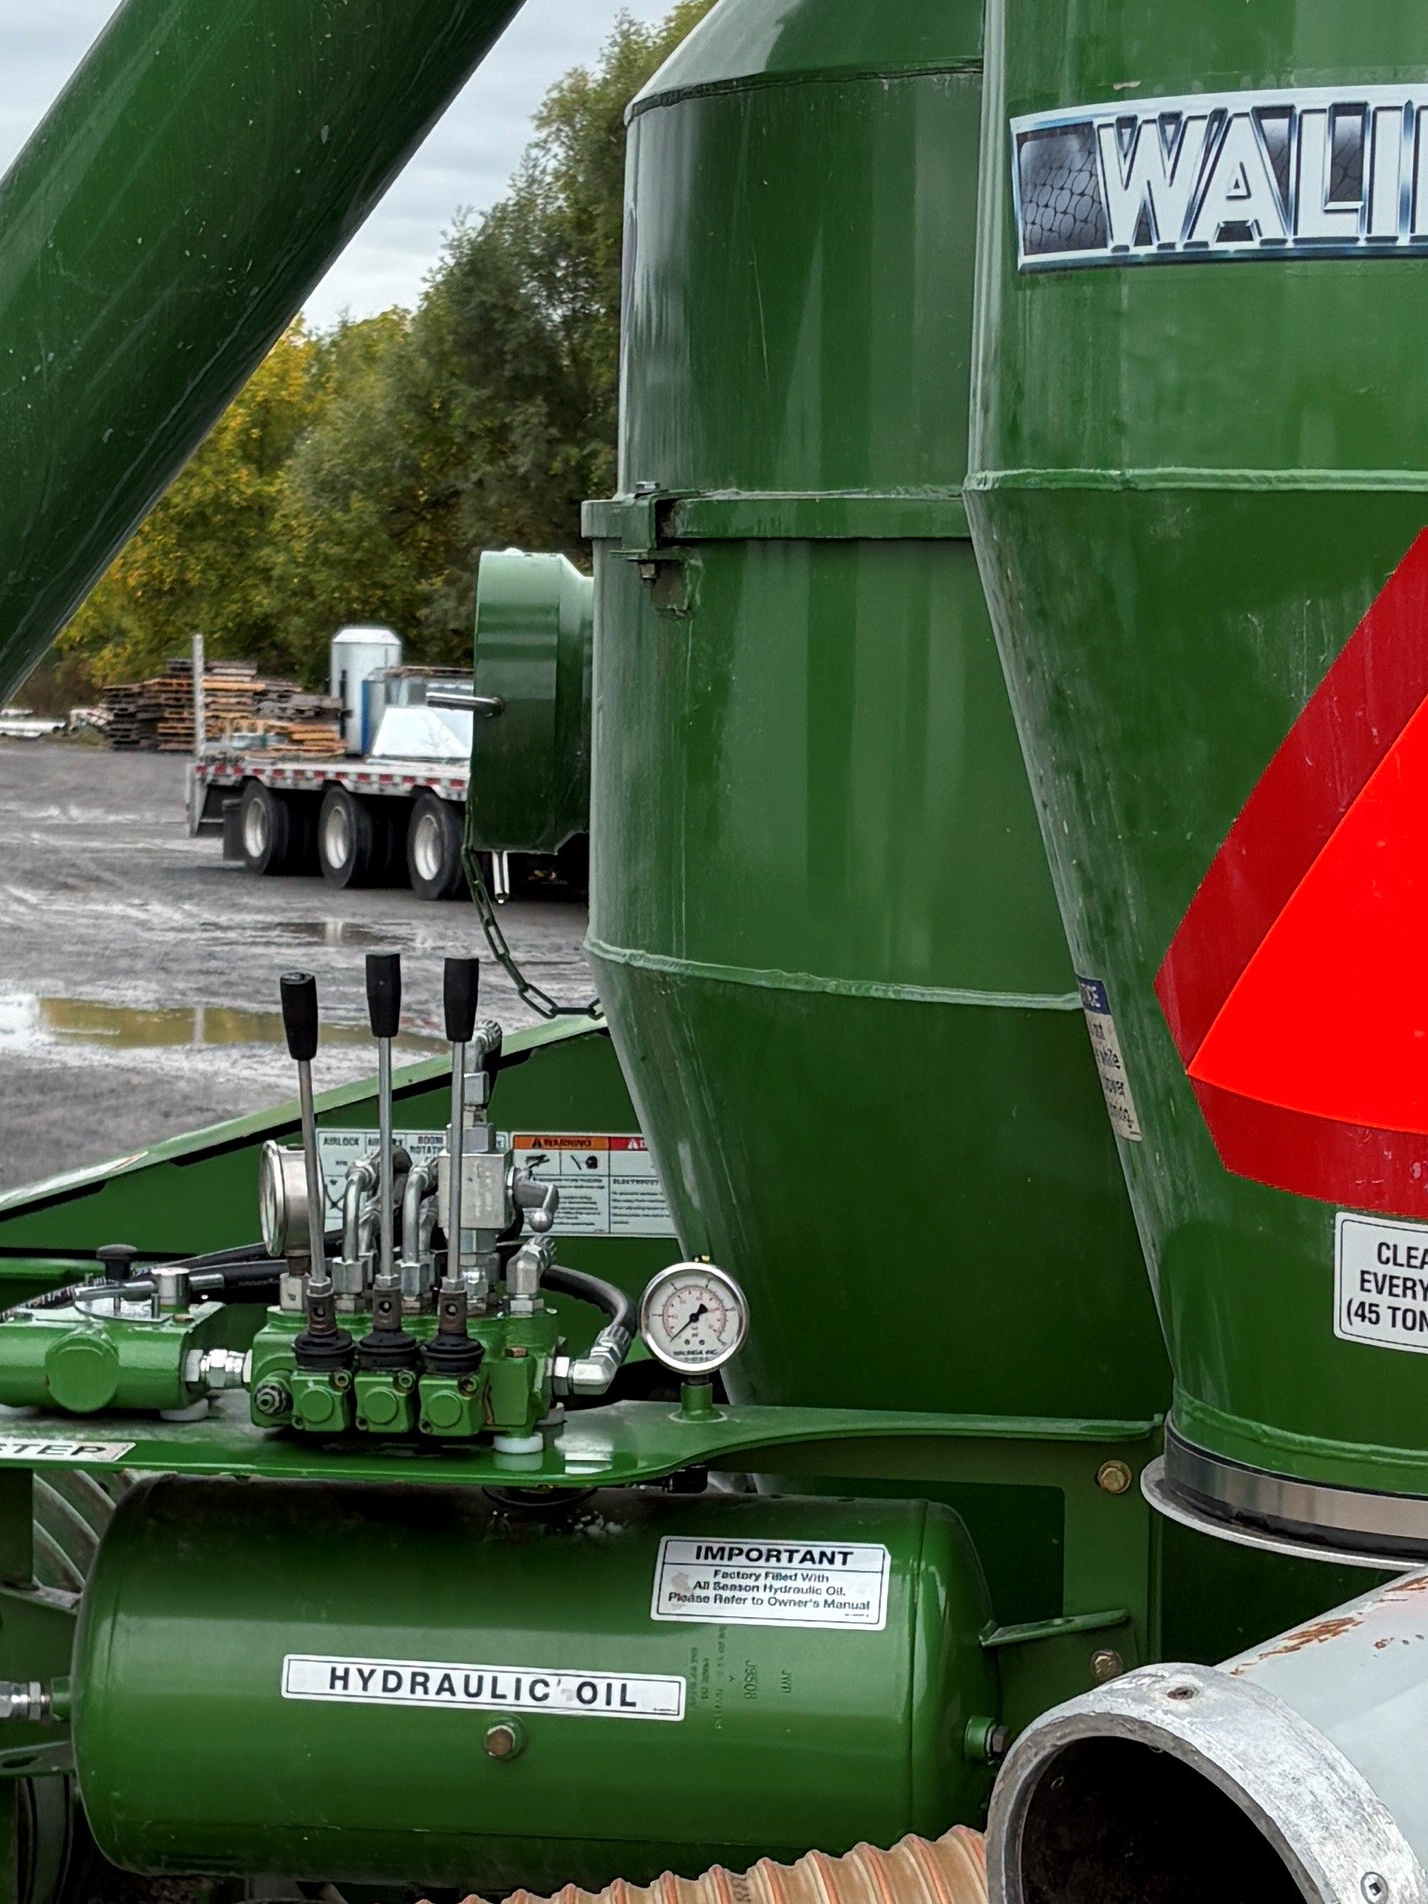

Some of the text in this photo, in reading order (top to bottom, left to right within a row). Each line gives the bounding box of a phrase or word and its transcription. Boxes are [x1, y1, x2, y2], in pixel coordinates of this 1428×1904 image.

[323, 1137, 360, 1146] AIRLOCK
[1346, 1297, 1381, 1326] (45
[695, 1545, 854, 1566] IMPORTANT
[713, 1569, 829, 1583] Factory Filled With
[693, 1581, 846, 1597] All Season Hydraulic Oil.
[668, 1592, 870, 1611] Please Refer to Owner's Manual
[329, 1666, 637, 1708] HYDRAULIC OIL
